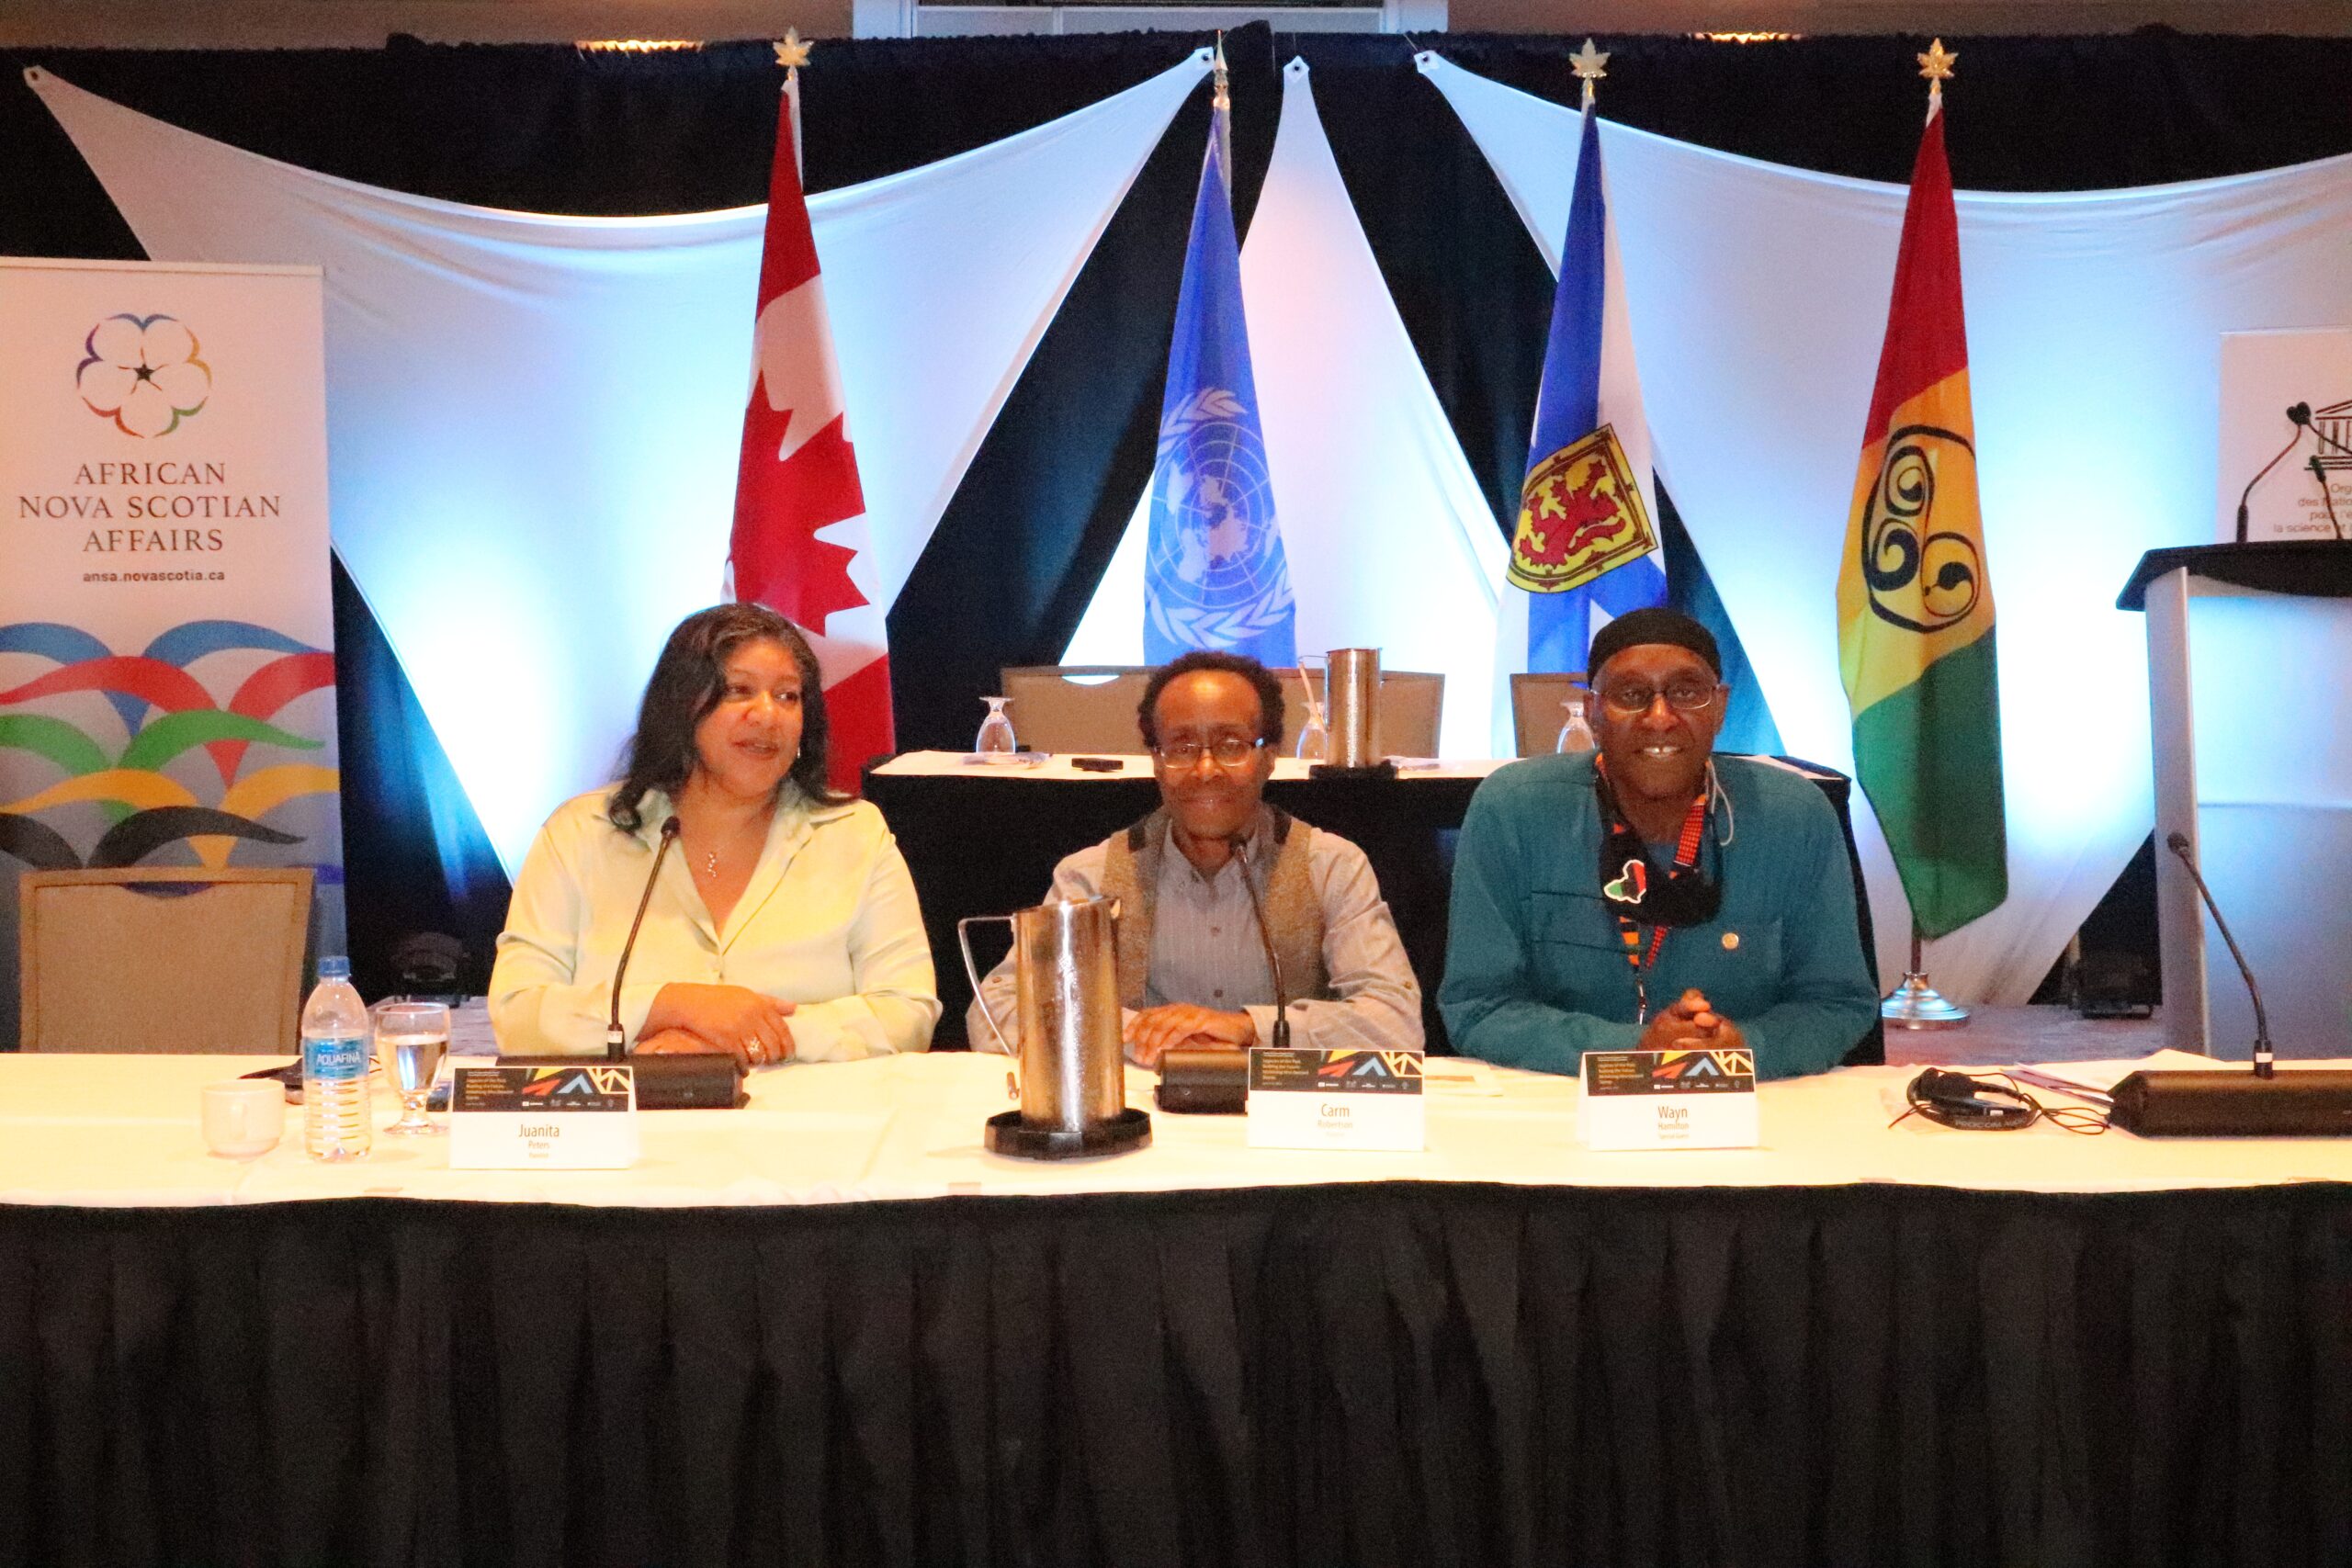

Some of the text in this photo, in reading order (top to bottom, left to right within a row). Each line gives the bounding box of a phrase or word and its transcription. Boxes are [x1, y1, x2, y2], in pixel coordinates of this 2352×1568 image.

[74, 462, 226, 485] AFRICAN
[18, 495, 281, 518] NOVA SCOTIAN
[2286, 523, 2331, 533] science
[82, 529, 224, 552] AFFAIRS
[83, 570, 226, 582] ansa.novascotia.ca
[316, 1051, 361, 1066] AQUAFINA
[1321, 1103, 1351, 1118] Carm
[1657, 1105, 1689, 1123] Wayn
[518, 1123, 560, 1138] Juanita
